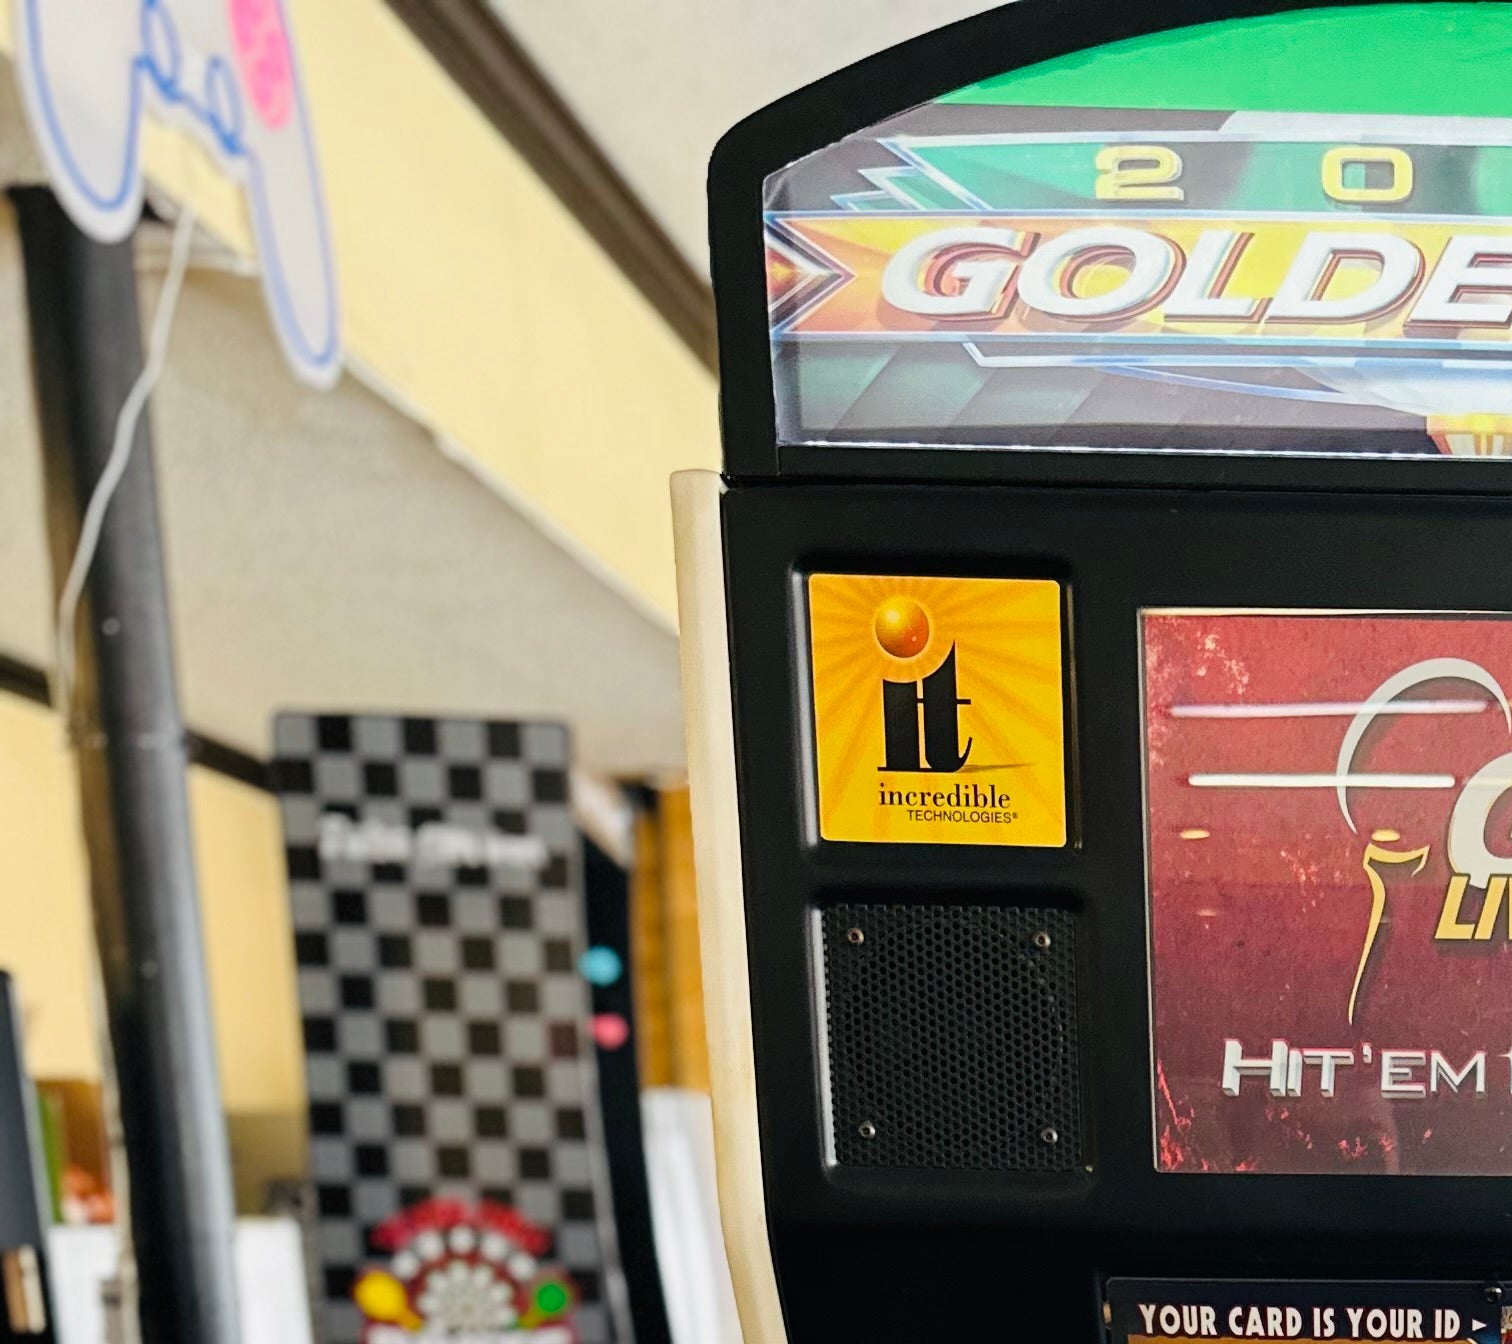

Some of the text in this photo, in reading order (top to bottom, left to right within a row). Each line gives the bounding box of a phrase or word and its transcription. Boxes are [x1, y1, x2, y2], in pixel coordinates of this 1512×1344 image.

[877, 782, 1012, 810] incredible
[1138, 1303, 1461, 1339] YOUR CARD IS YOUR ID
